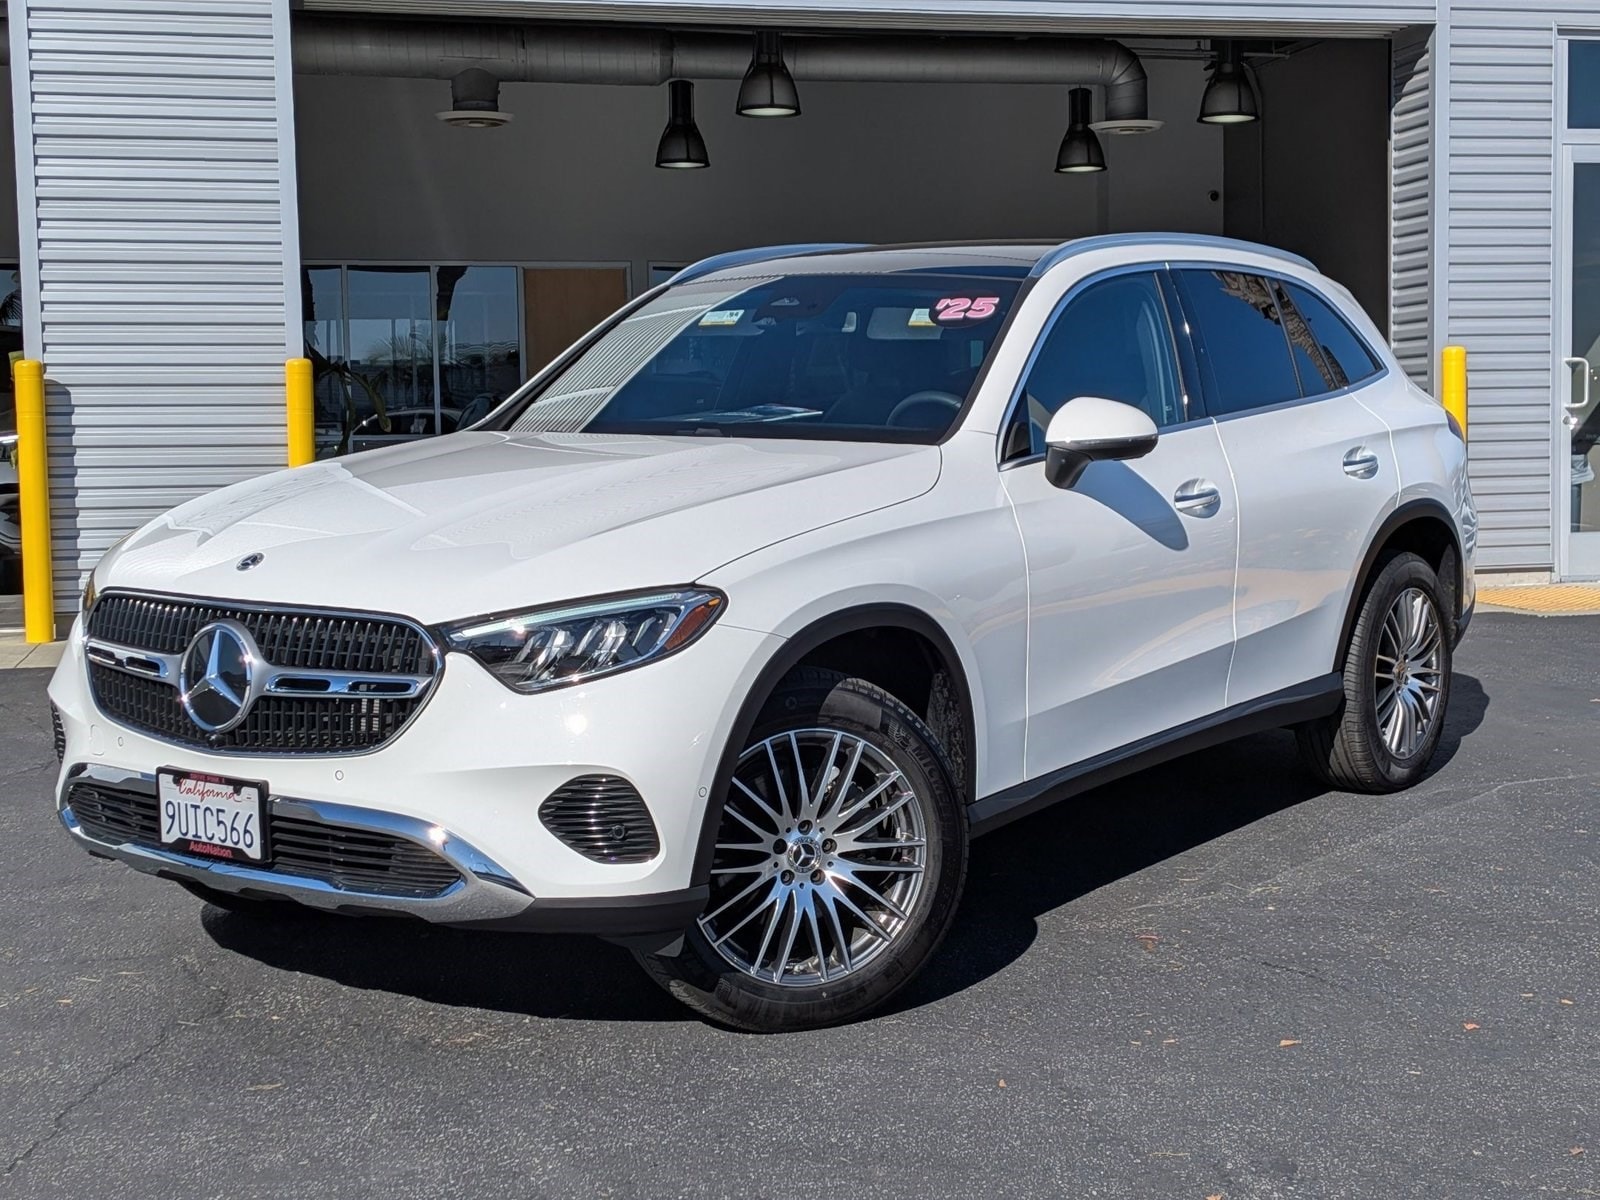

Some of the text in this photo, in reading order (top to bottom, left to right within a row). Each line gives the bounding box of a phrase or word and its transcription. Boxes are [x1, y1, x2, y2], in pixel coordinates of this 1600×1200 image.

[178, 778, 242, 803] California
[165, 800, 254, 849] 9UIC566
[189, 841, 233, 858] AutoNation
